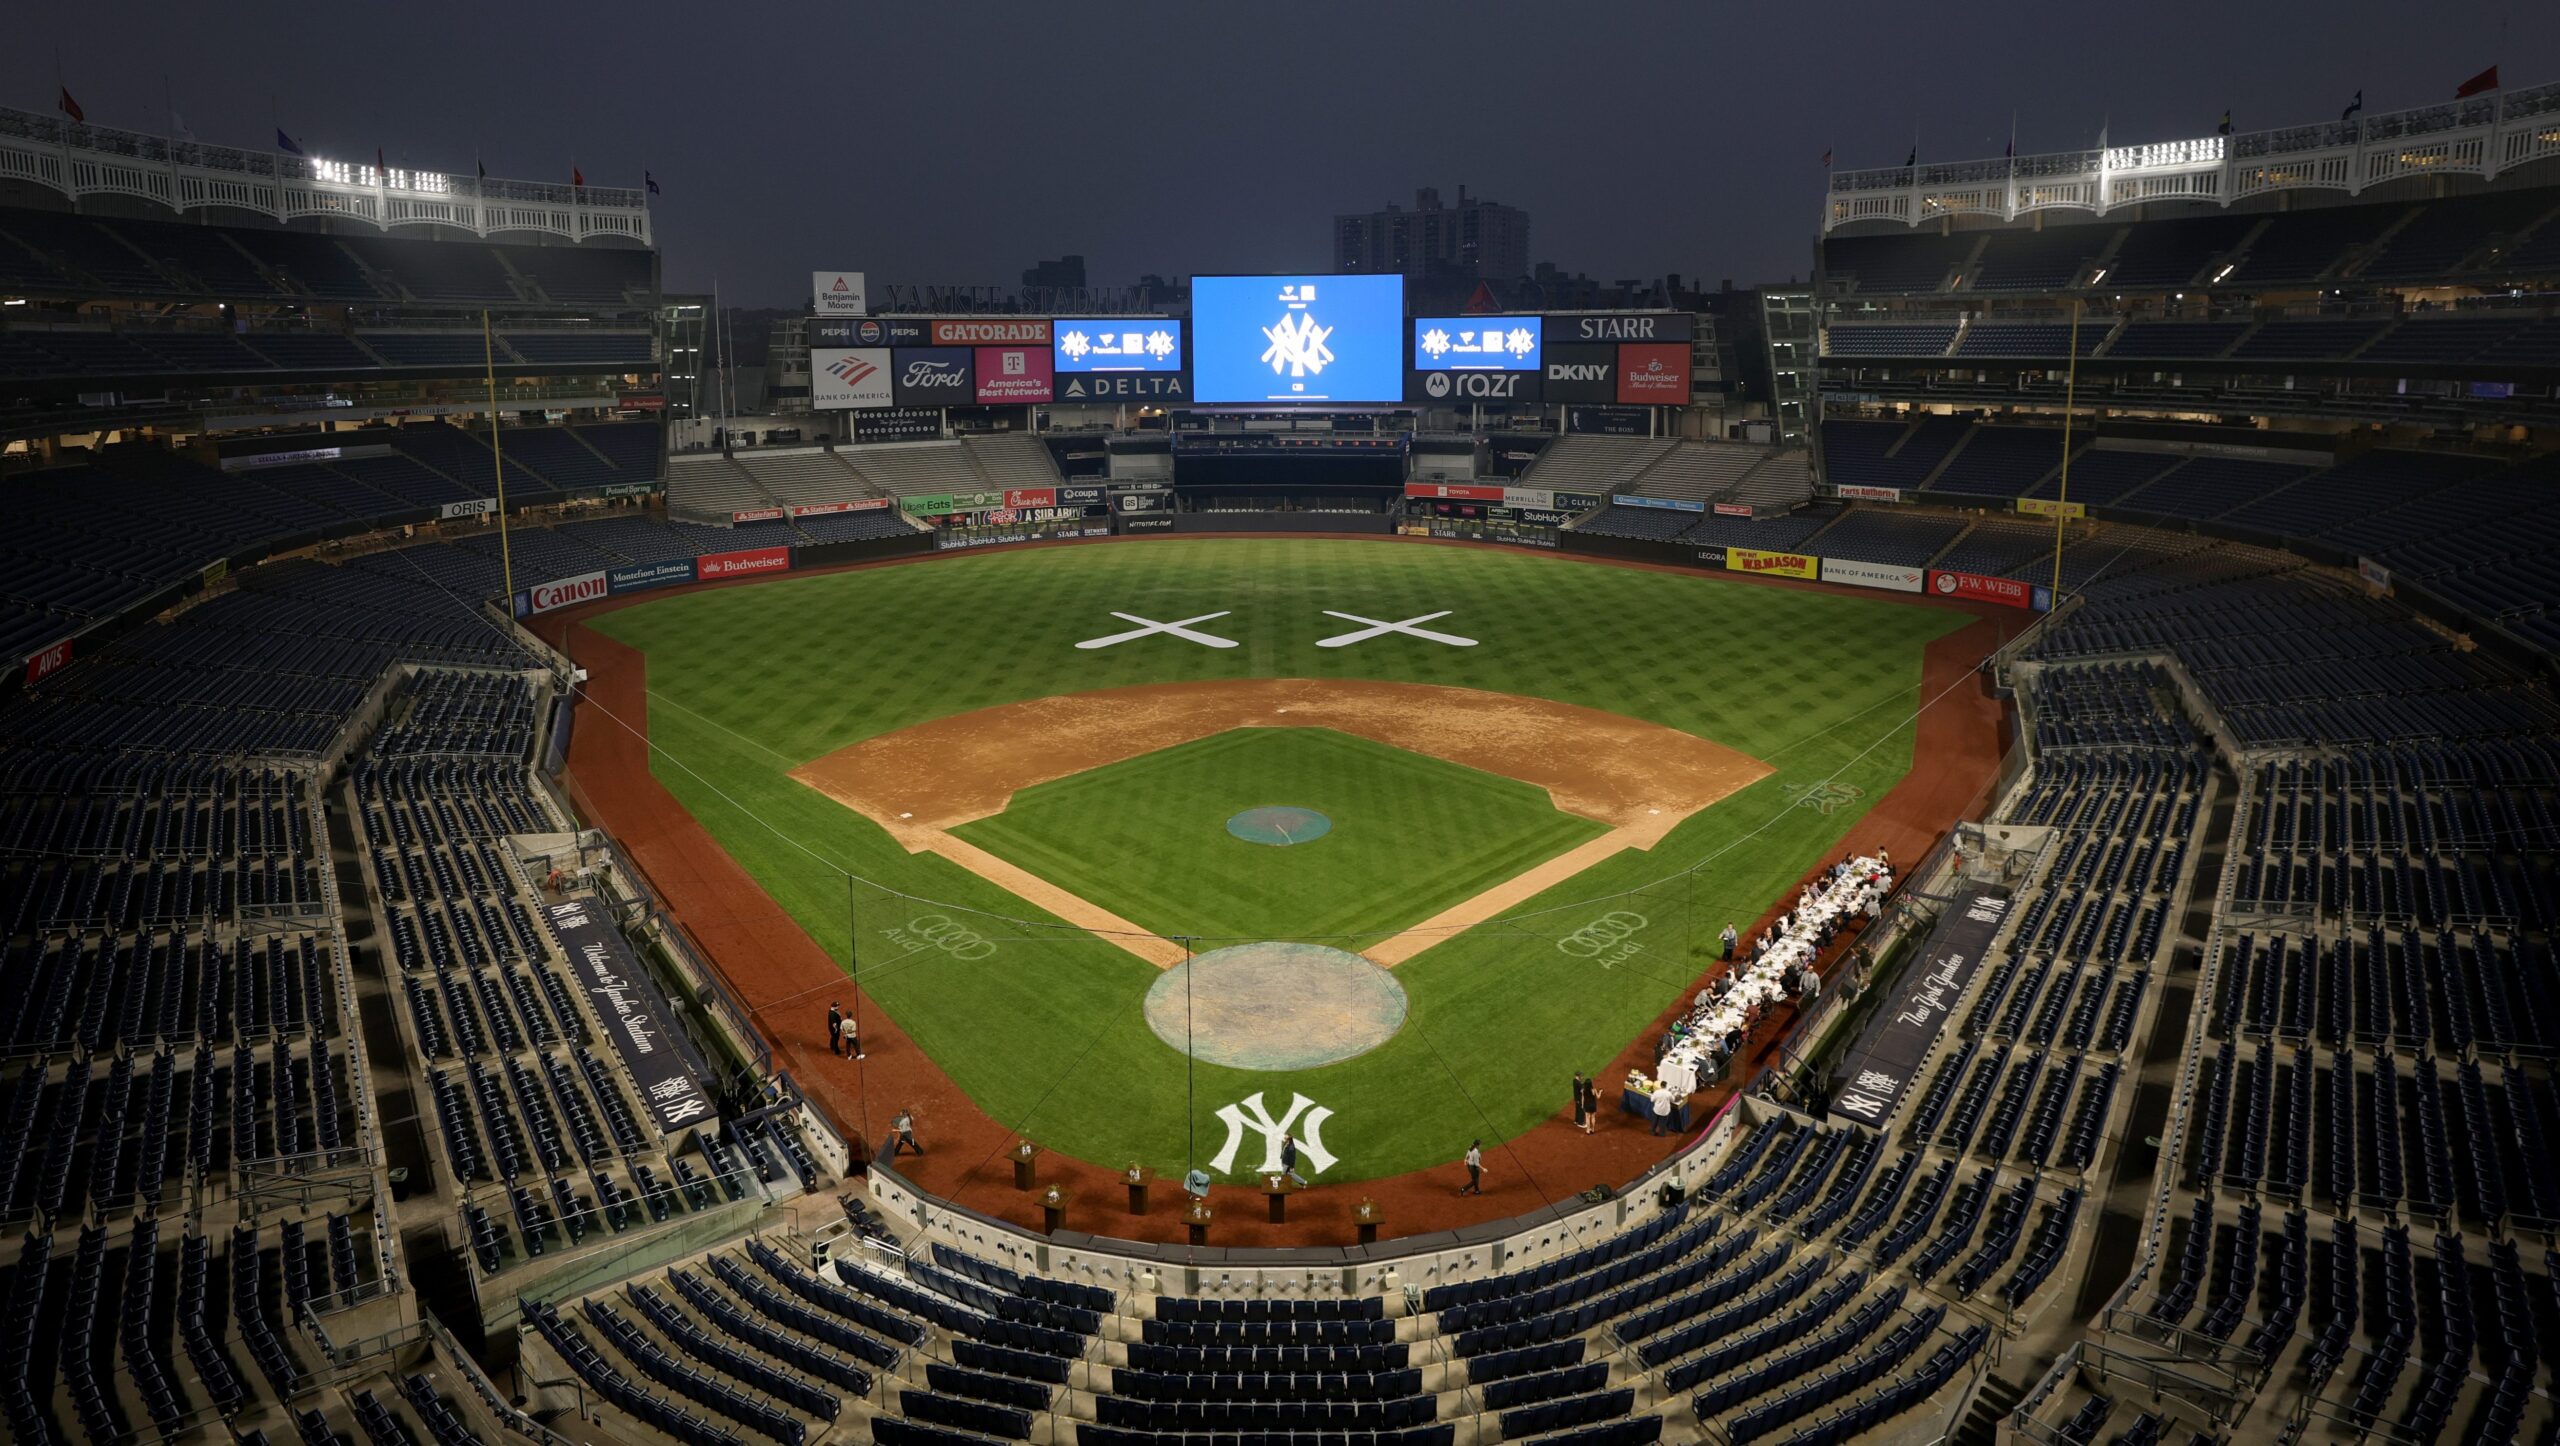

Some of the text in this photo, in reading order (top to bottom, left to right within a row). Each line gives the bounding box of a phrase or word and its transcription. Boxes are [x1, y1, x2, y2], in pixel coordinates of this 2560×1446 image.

[822, 293, 860, 303] Benjamin
[884, 284, 1150, 314] YANKEE STADIUM
[827, 302, 854, 310] Moore
[821, 328, 850, 336] PEPSI
[890, 328, 919, 336] PEPSI
[938, 324, 1046, 341] GATORADE
[1580, 318, 1655, 339] STARR
[902, 361, 966, 388] Ford
[1548, 364, 1609, 381] DKNY
[1630, 371, 1679, 382] Budweiser
[987, 379, 1042, 388] America's
[1095, 378, 1183, 395] DELTA
[1456, 373, 1520, 397] razr
[852, 392, 891, 400] AMERICA
[978, 387, 1051, 397] Best Network
[606, 485, 651, 496] Poland Spring
[1074, 490, 1098, 499] coupa
[1840, 488, 1860, 496] Parts
[1861, 488, 1896, 498] Authority
[451, 501, 486, 516] ORIS
[902, 501, 951, 512] Uber Eats
[1571, 499, 1597, 507] CLEAR
[1025, 510, 1032, 522] A
[1524, 511, 1559, 523] StubHub
[1057, 530, 1079, 538] STARR
[1434, 530, 1457, 538] STARR
[940, 540, 968, 550] StubHub
[968, 537, 996, 547] StubHub
[998, 534, 1026, 543] StubHub
[723, 556, 785, 572] Budweiser
[1698, 551, 1726, 562] LEGORA
[613, 563, 689, 583] Montefiore Einstein
[1824, 567, 1900, 582] BANK OF AMERICA
[533, 577, 605, 610] Canon
[1958, 576, 2022, 597] F.W. WEBB
[38, 644, 63, 677] AVIS
[1596, 939, 1646, 969] Audi
[1897, 953, 1964, 1027] New York Yankees
[581, 942, 656, 1054] Welcome to Yankee Stadium
[1208, 1091, 1341, 1175] NY
